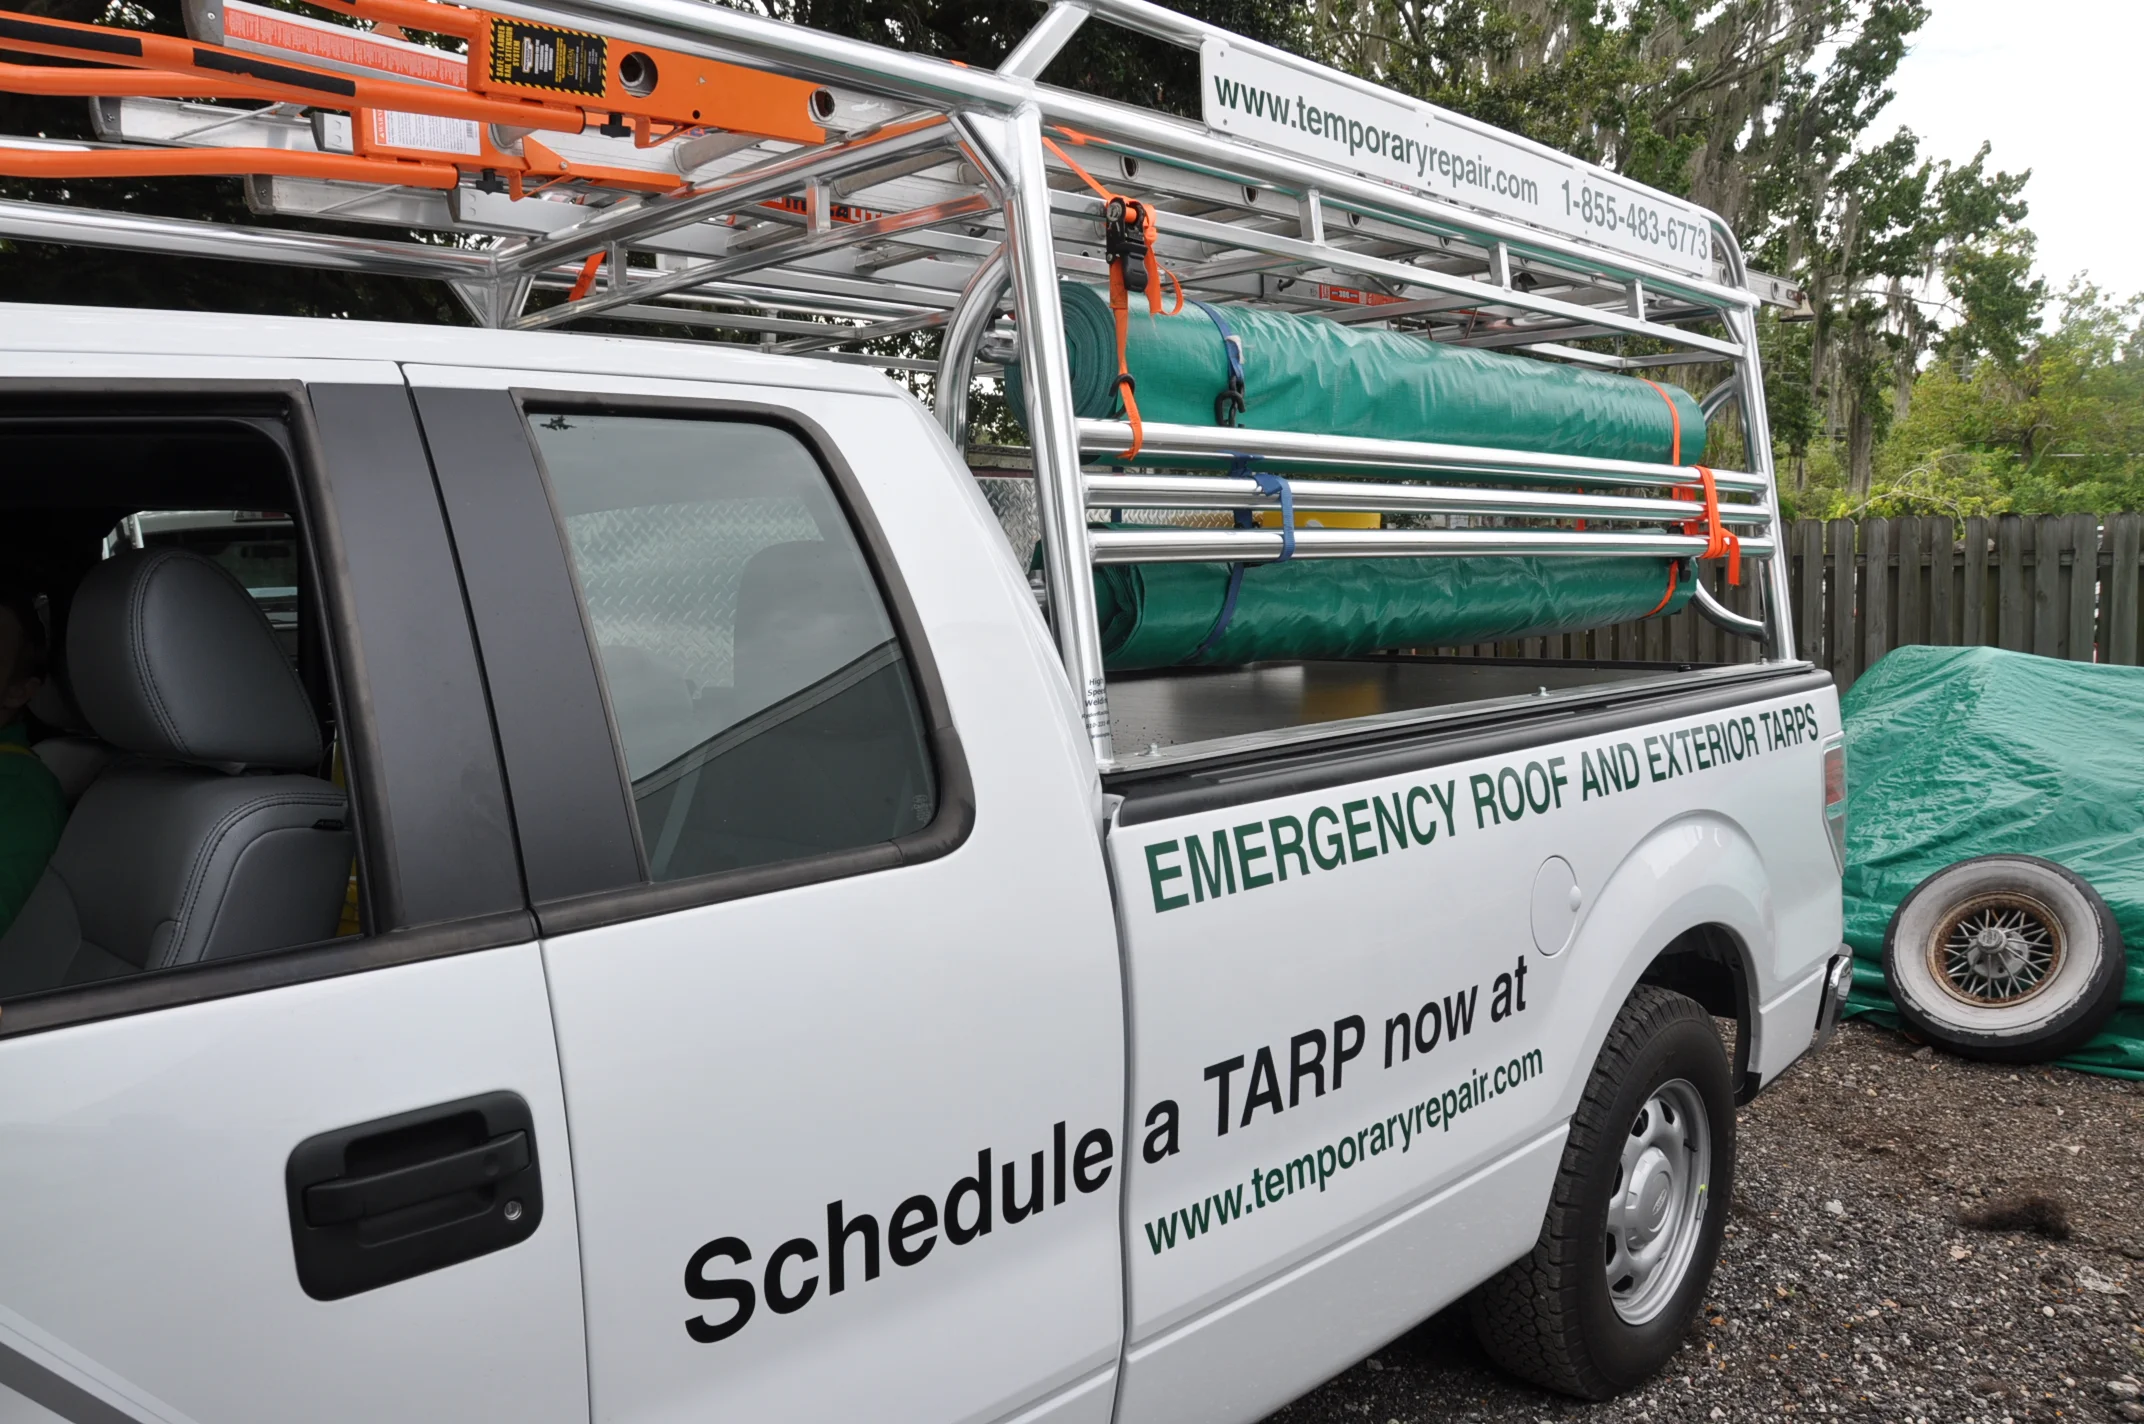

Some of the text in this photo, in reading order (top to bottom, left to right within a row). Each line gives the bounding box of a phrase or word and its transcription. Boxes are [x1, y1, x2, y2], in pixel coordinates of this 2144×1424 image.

[496, 25, 505, 77] SAFE-T LADDER
[504, 25, 513, 78] RAIL EXTENSION
[512, 40, 520, 67] SYSTEM
[1214, 76, 1707, 260] www.temporaryrepair.com 1-855-483-6773
[1144, 702, 1819, 913] EMERGENCY ROOF AND EXTERIOR TARPS
[685, 956, 1528, 1343] Schedule a TARP now at
[1145, 1049, 1542, 1255] www.temporaryrepair.com
